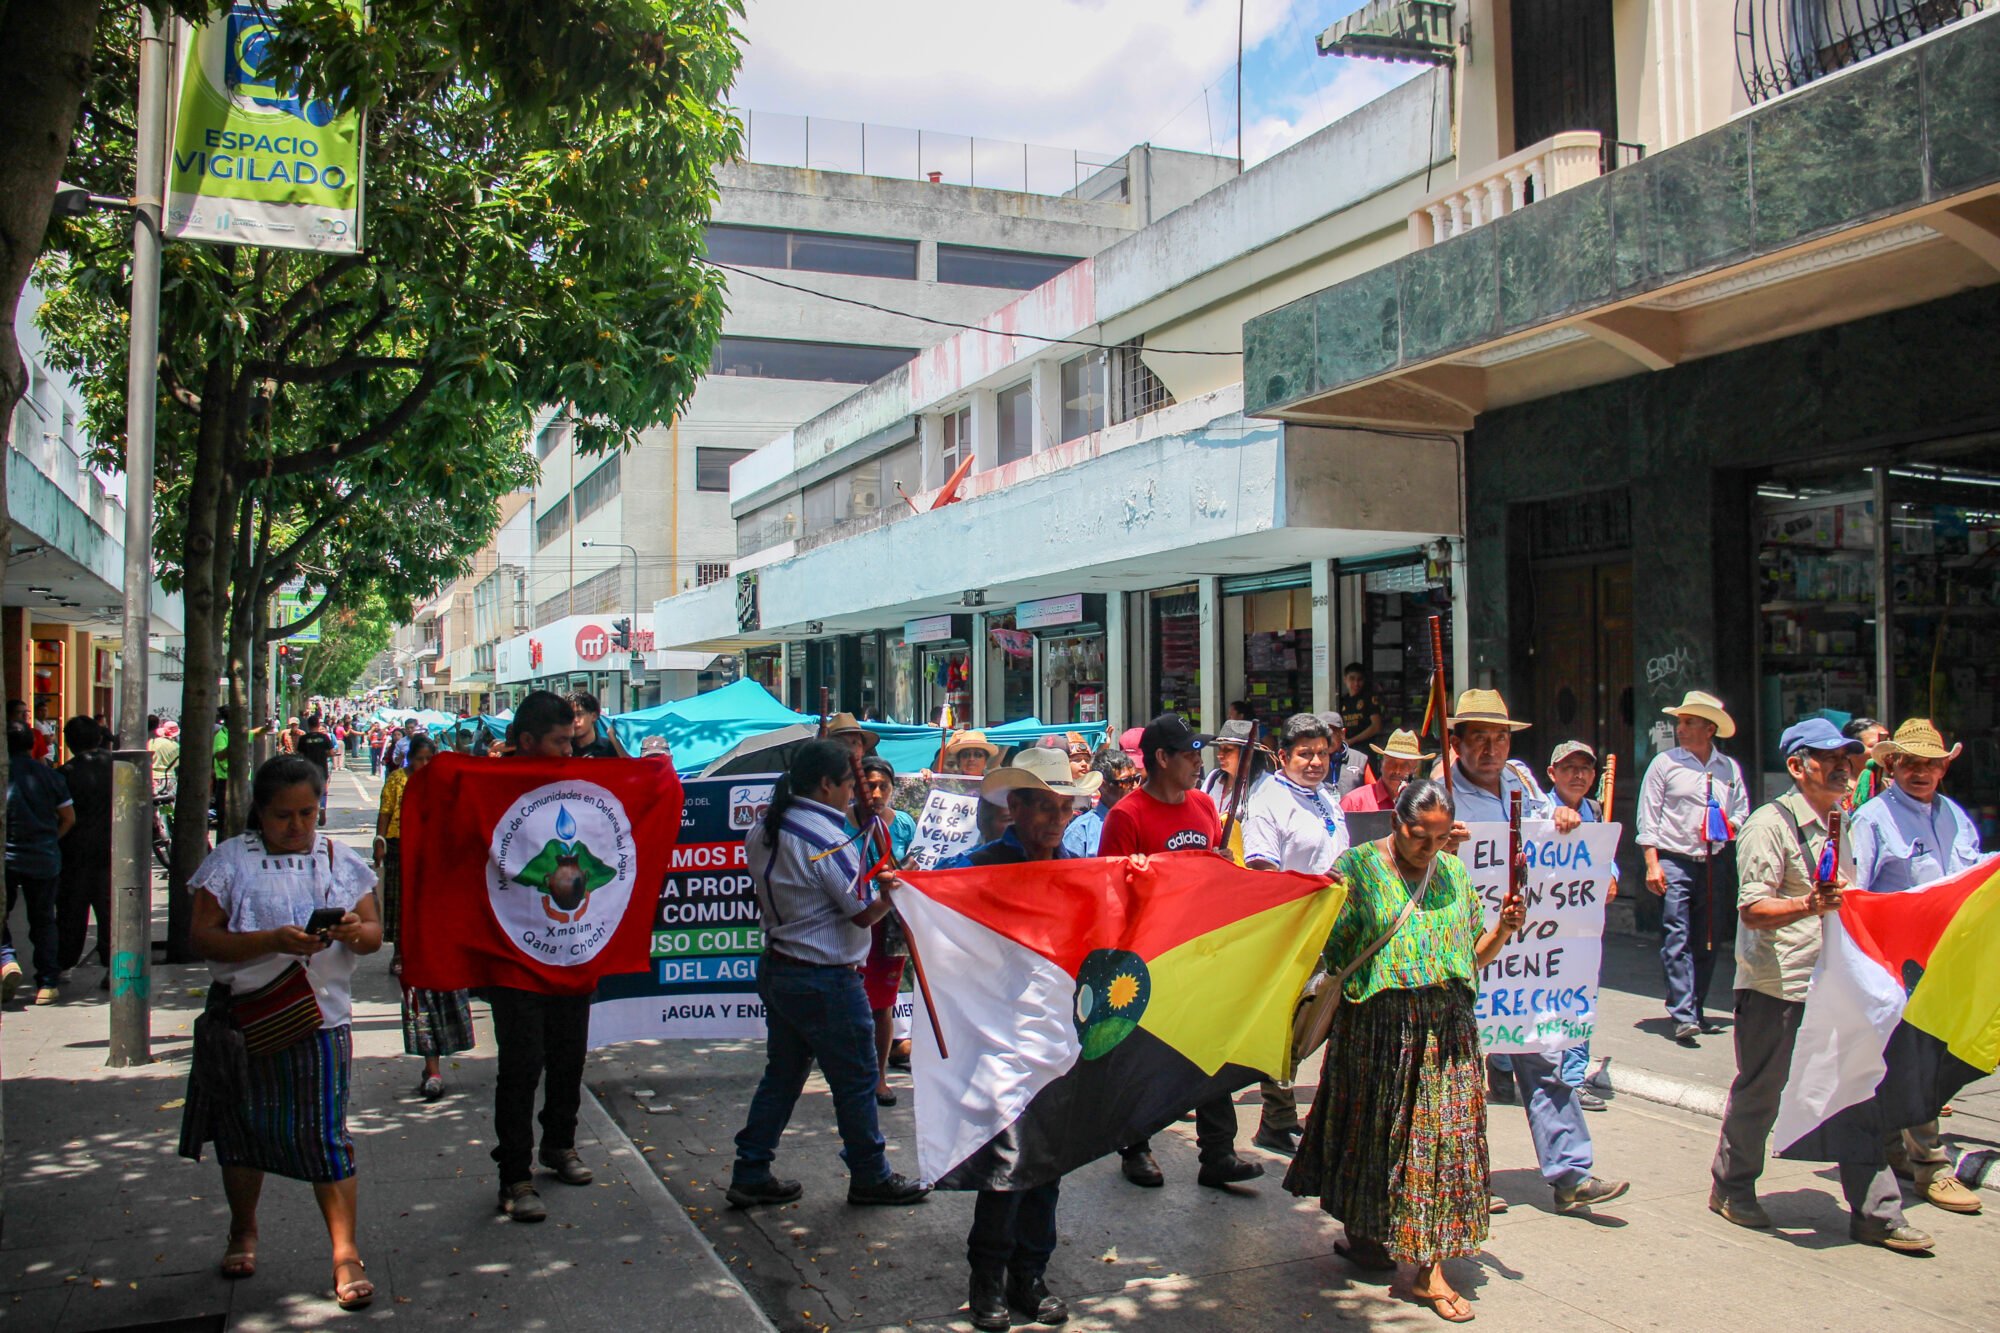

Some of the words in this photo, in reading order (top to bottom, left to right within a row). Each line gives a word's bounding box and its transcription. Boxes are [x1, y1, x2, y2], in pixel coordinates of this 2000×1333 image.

[205, 128, 319, 157] ESPACIO
[175, 149, 346, 190] VIGILADO
[582, 634, 604, 656] mf
[521, 790, 582, 817] Comunidades
[584, 794, 596, 805] en
[695, 797, 711, 806] DEL
[931, 797, 947, 810] EL
[952, 803, 978, 817] AGU
[511, 817, 523, 831] de
[596, 798, 621, 834] Defensa
[924, 813, 942, 824] NO
[946, 817, 960, 827] SE
[617, 835, 626, 850] del
[922, 825, 972, 843] VENDE
[1168, 829, 1208, 850] adidas
[668, 846, 726, 868] MOS
[932, 843, 949, 854] SE
[1474, 840, 1504, 869] EL
[1522, 840, 1592, 870] AGUA
[497, 832, 513, 891] Mimiento
[618, 852, 628, 881] Agua
[659, 878, 680, 899] A
[1550, 879, 1596, 911] SER
[545, 922, 592, 937] Xmolam
[1504, 920, 1559, 946] VO
[665, 961, 709, 981] DEL
[1483, 948, 1564, 982] TIENE
[662, 1004, 715, 1022] ¡AGUA
[720, 1004, 731, 1018] Y
[1536, 1017, 1594, 1041] PRESENTE
